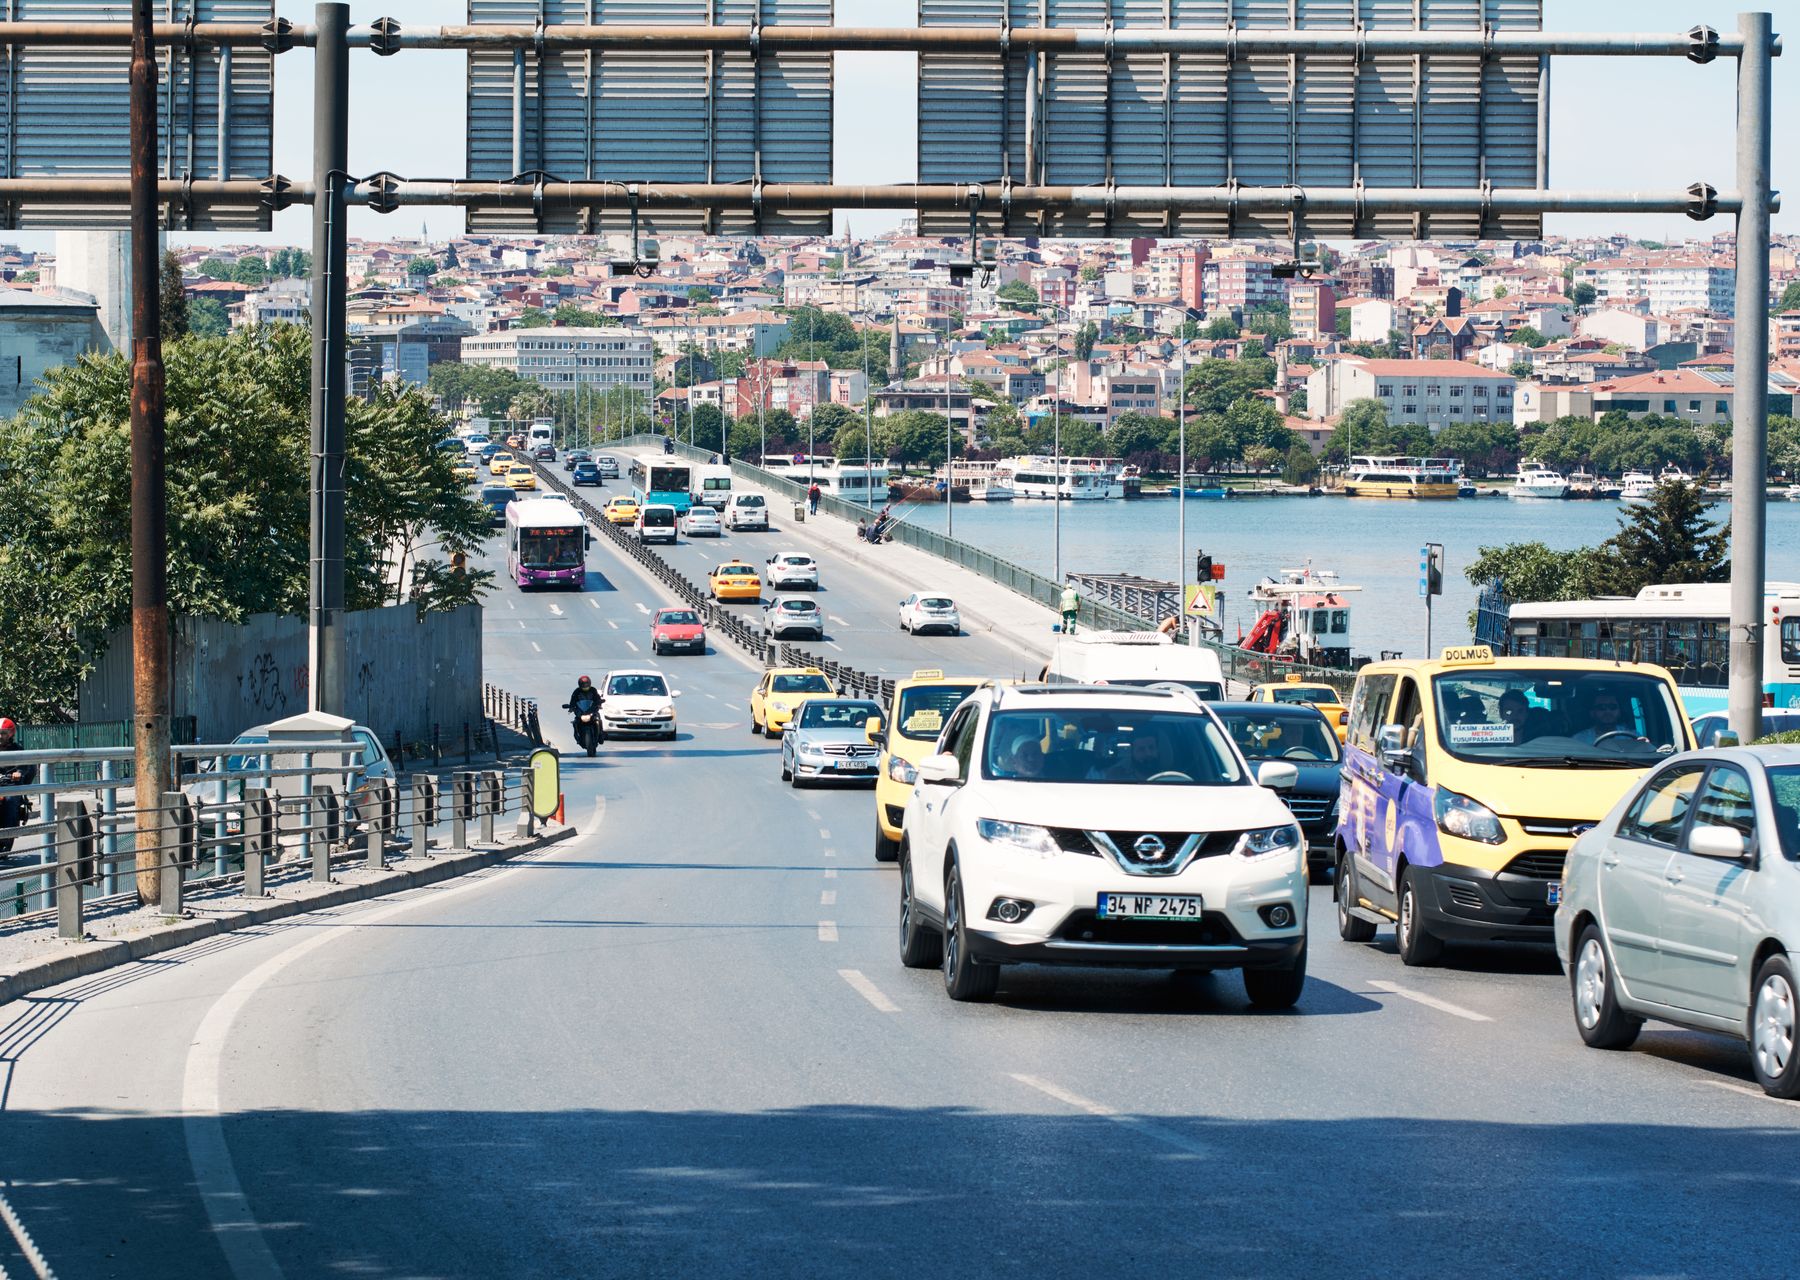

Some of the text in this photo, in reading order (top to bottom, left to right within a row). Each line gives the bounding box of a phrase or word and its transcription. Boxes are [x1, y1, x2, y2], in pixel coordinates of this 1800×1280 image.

[1108, 896, 1126, 913] 34
[1134, 897, 1153, 914] NP
[1159, 898, 1196, 915] 2475
